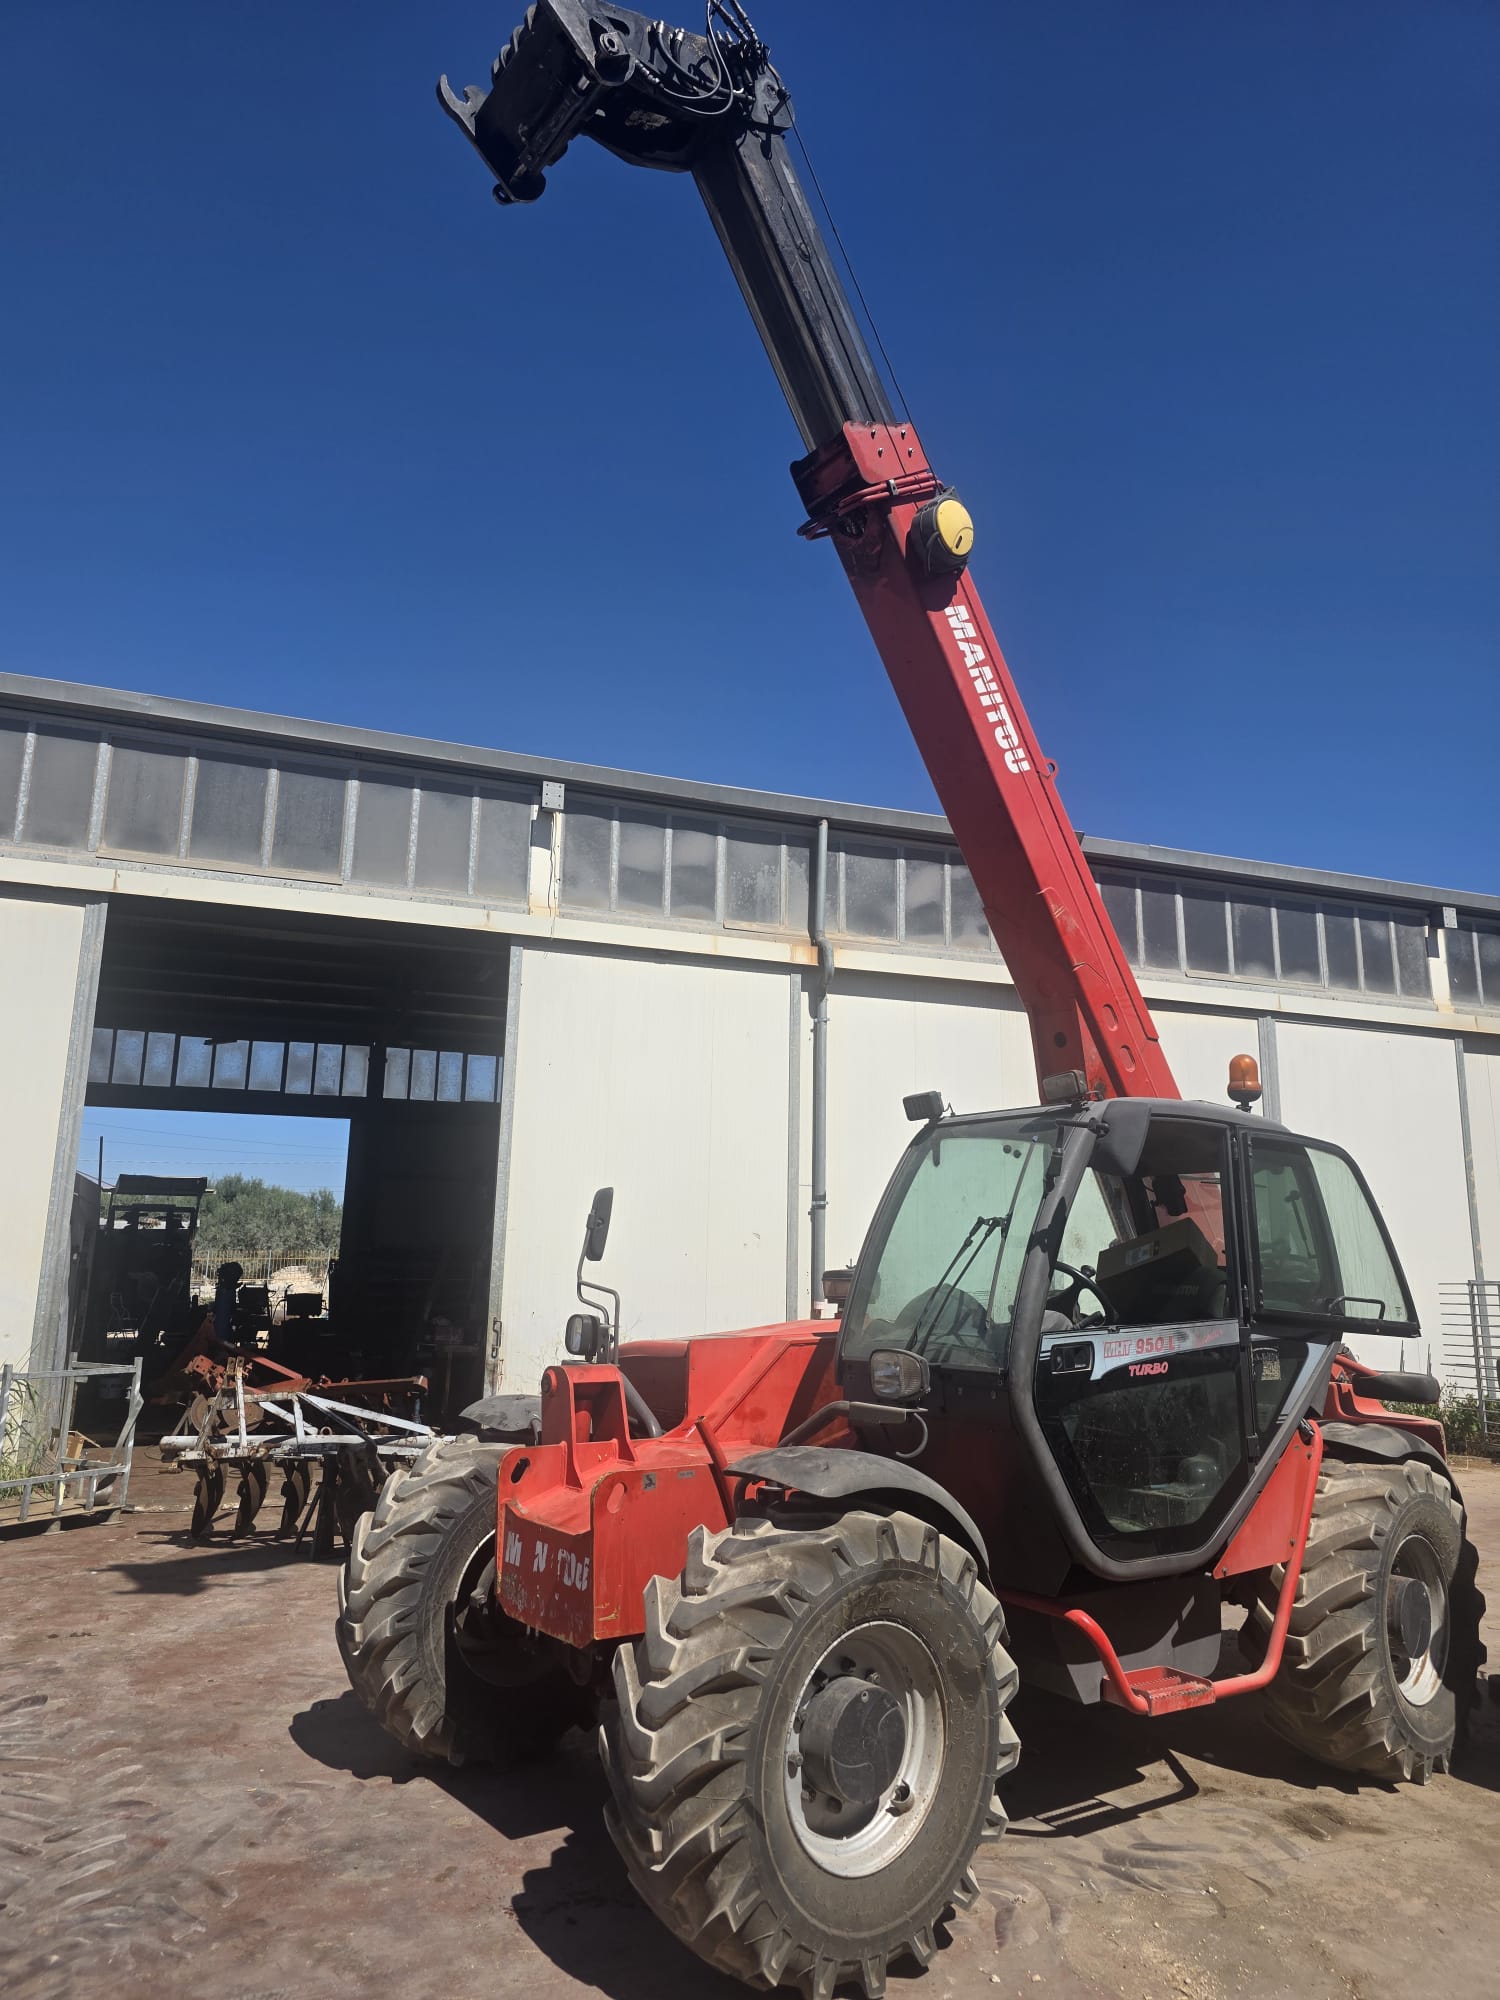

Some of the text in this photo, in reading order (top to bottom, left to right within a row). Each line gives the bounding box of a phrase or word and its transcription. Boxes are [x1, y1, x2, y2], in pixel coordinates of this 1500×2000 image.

[944, 604, 1031, 774] MANITOU
[1103, 1340, 1132, 1359] MHT
[1135, 1337, 1165, 1355] 950
[1168, 1334, 1176, 1351] L
[1128, 1361, 1169, 1377] TURBO
